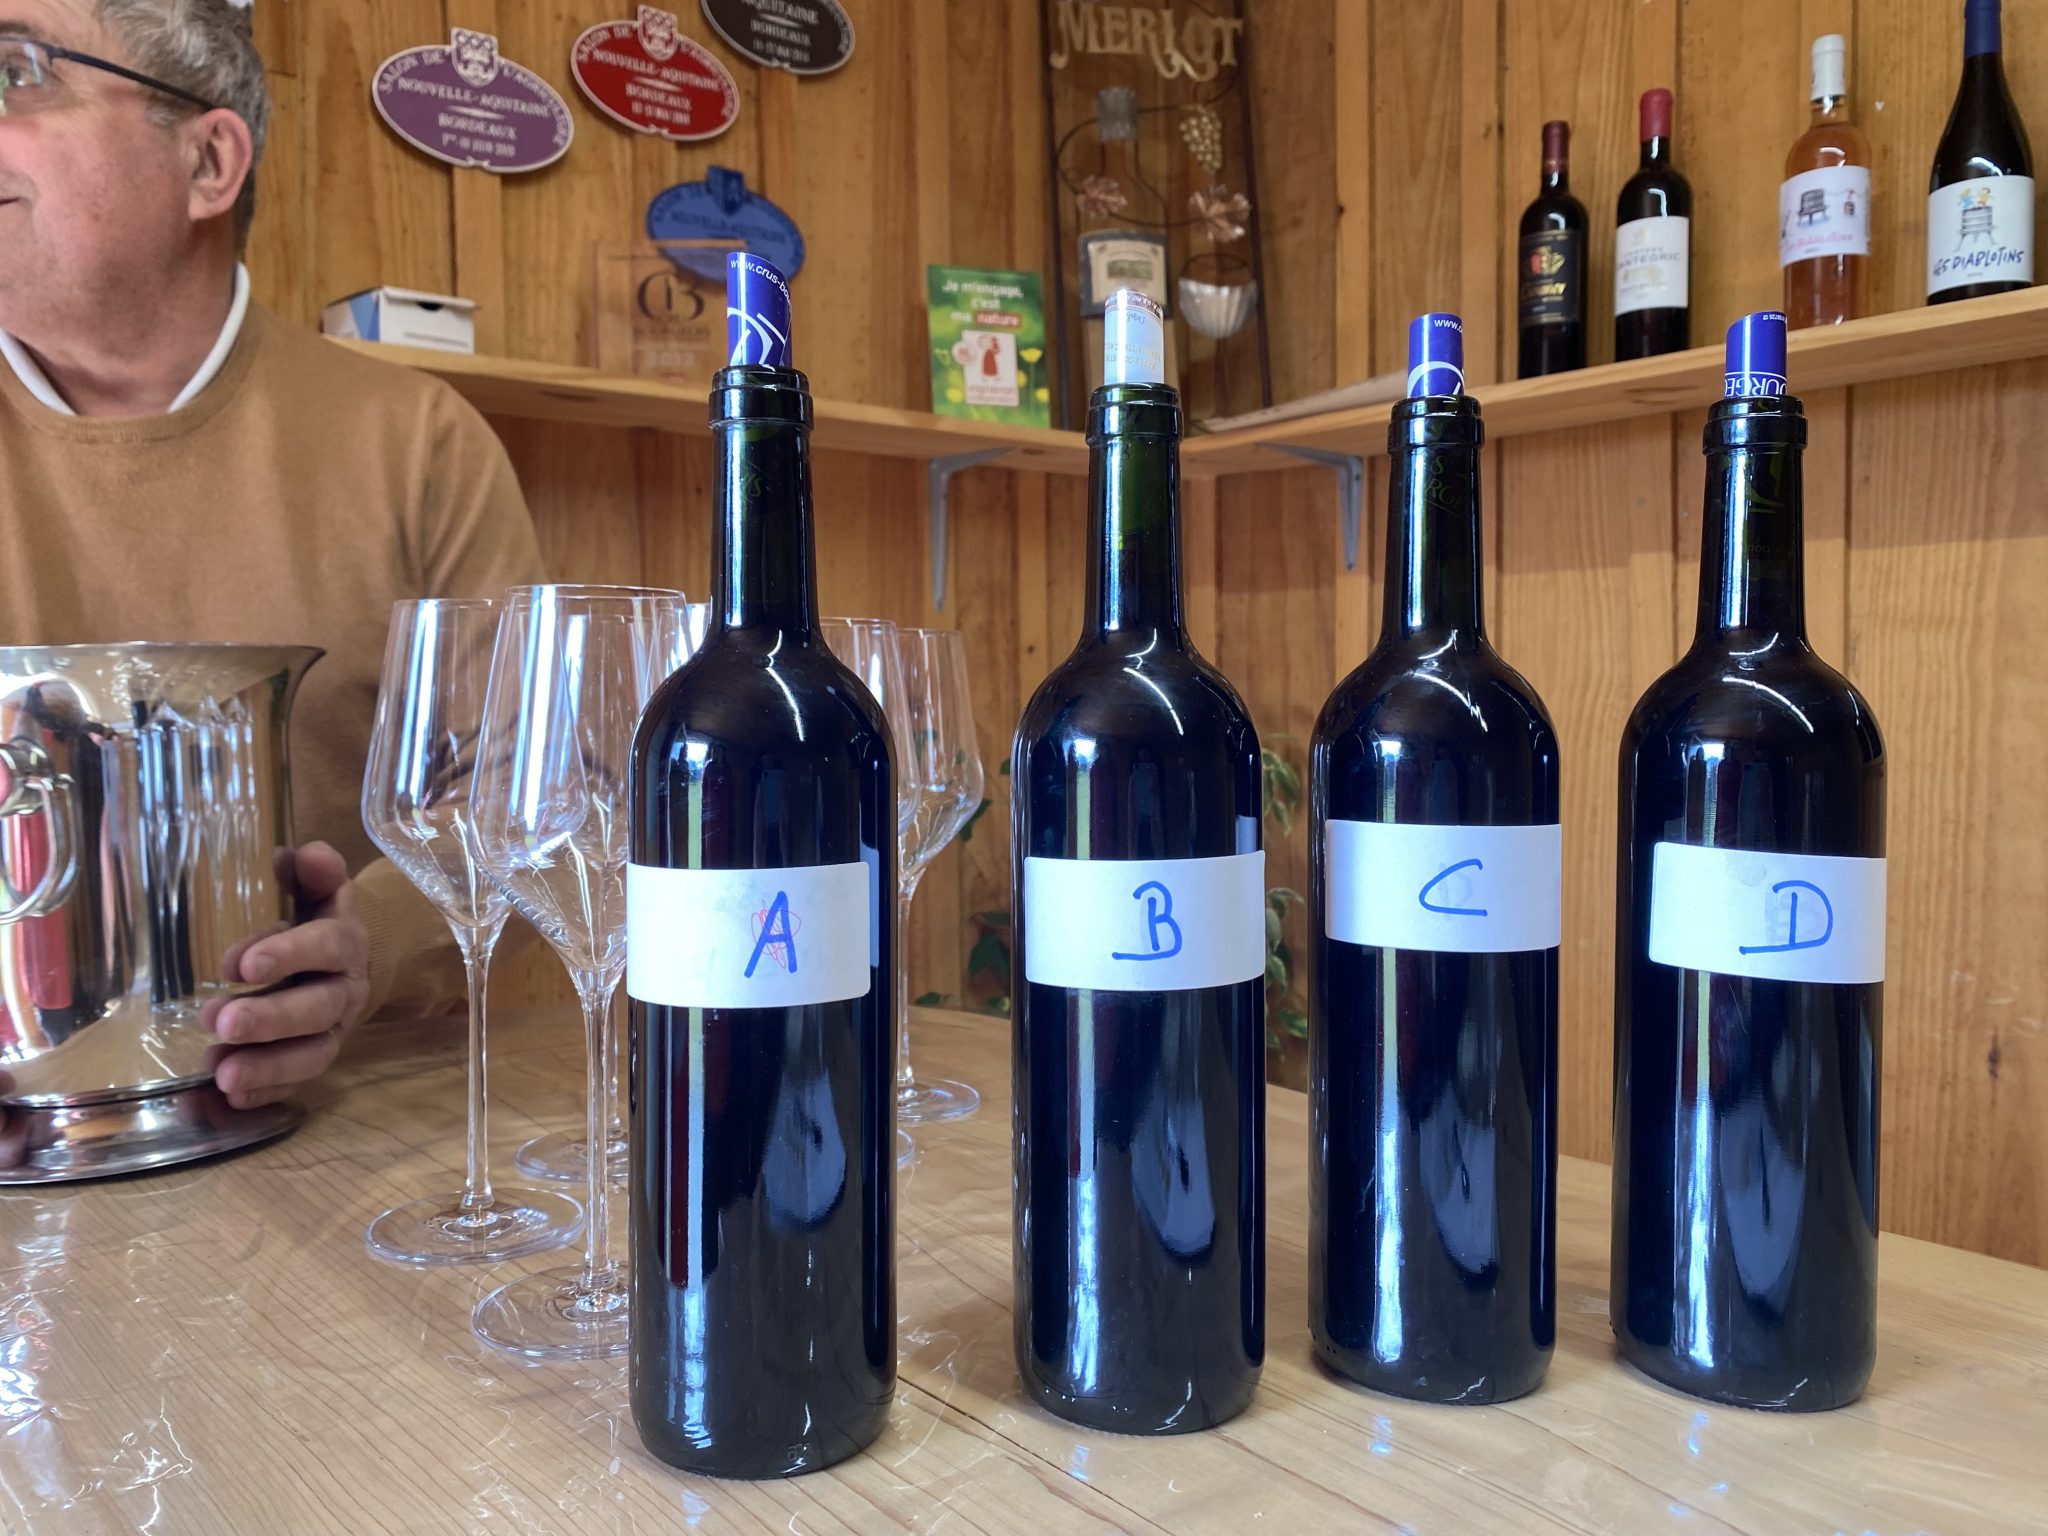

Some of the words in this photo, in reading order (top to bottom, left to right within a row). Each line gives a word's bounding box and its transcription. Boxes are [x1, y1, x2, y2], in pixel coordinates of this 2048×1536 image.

[422, 50, 446, 66] DE
[1051, 0, 1243, 82] MERLOT
[438, 113, 517, 139] BORDEAUX
[1951, 246, 2025, 270] DIABLOTINS
[1111, 880, 1183, 961] B
[1418, 858, 1488, 917] C
[1739, 879, 1834, 955] D
[744, 890, 798, 979] A
